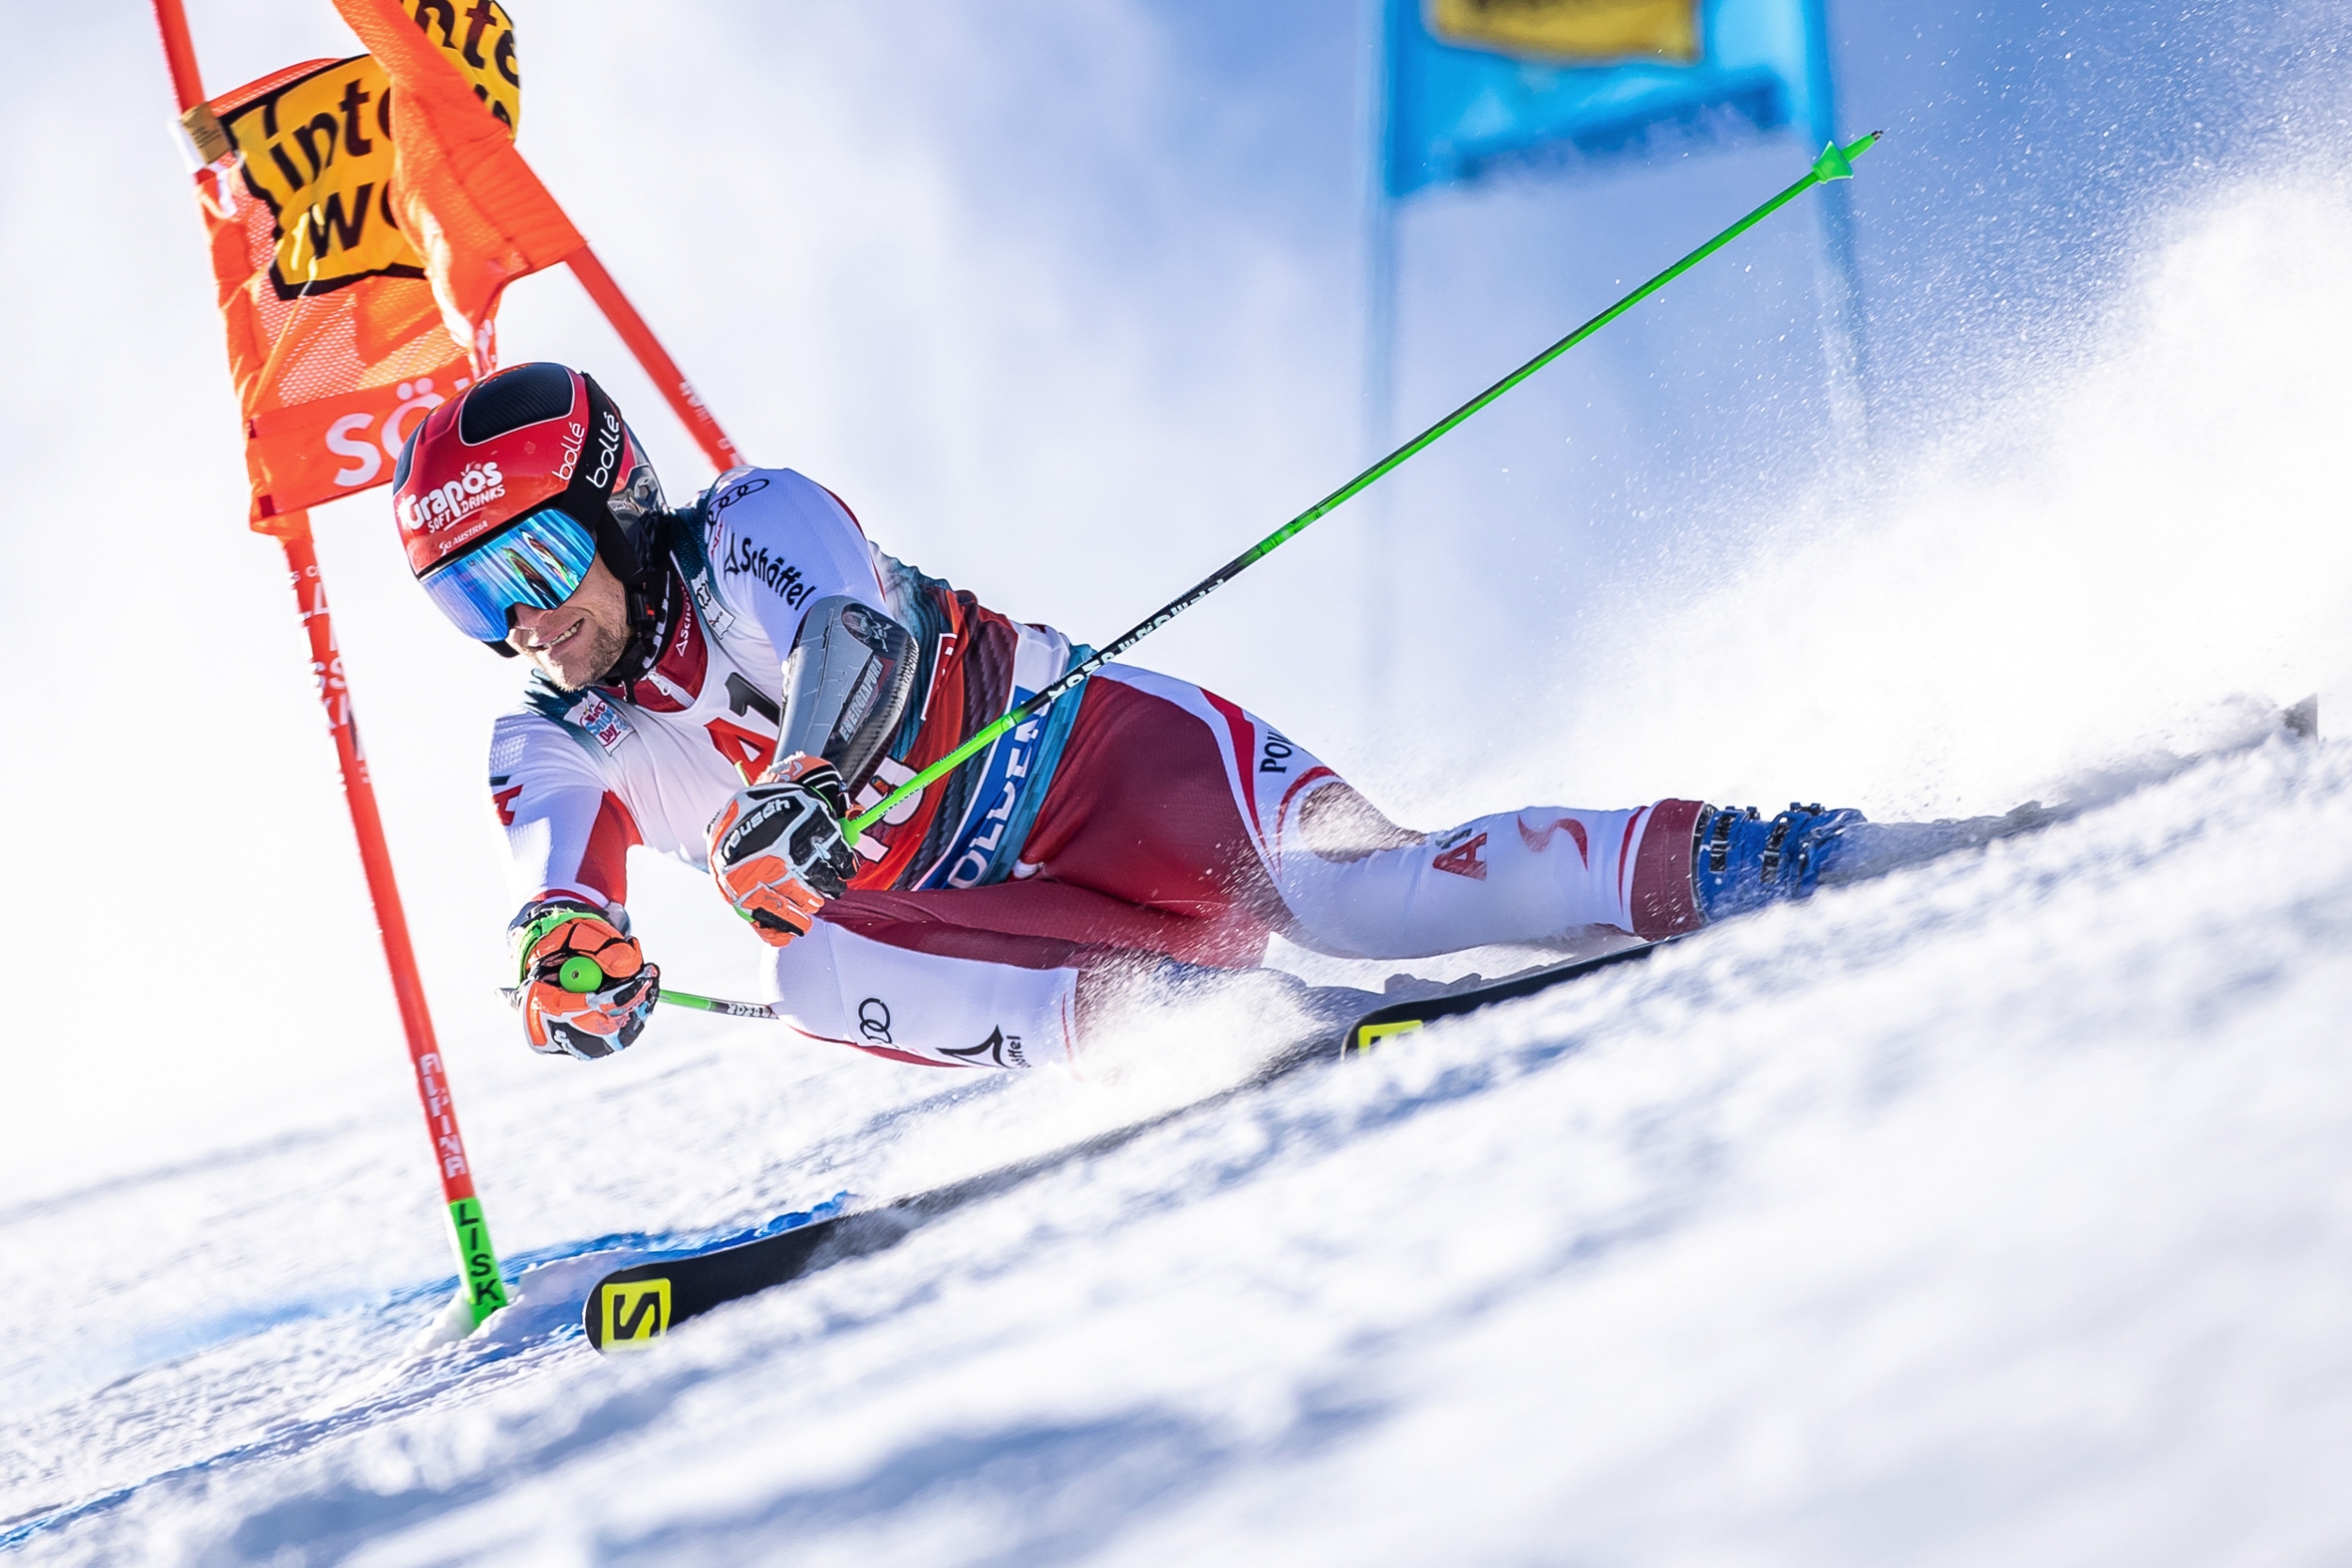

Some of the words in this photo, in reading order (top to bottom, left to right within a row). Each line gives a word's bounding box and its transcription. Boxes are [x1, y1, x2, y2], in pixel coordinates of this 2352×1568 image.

[326, 377, 470, 486] SÖ
[551, 421, 584, 481] bollé
[586, 412, 619, 488] bollé
[427, 509, 452, 534] SOFT
[460, 483, 506, 514] DRINKS
[452, 519, 488, 546] AUSTRIA
[739, 537, 817, 611] Schöffel
[598, 723, 618, 743] Day
[723, 799, 790, 860] reusch
[458, 1202, 501, 1314] LISK
